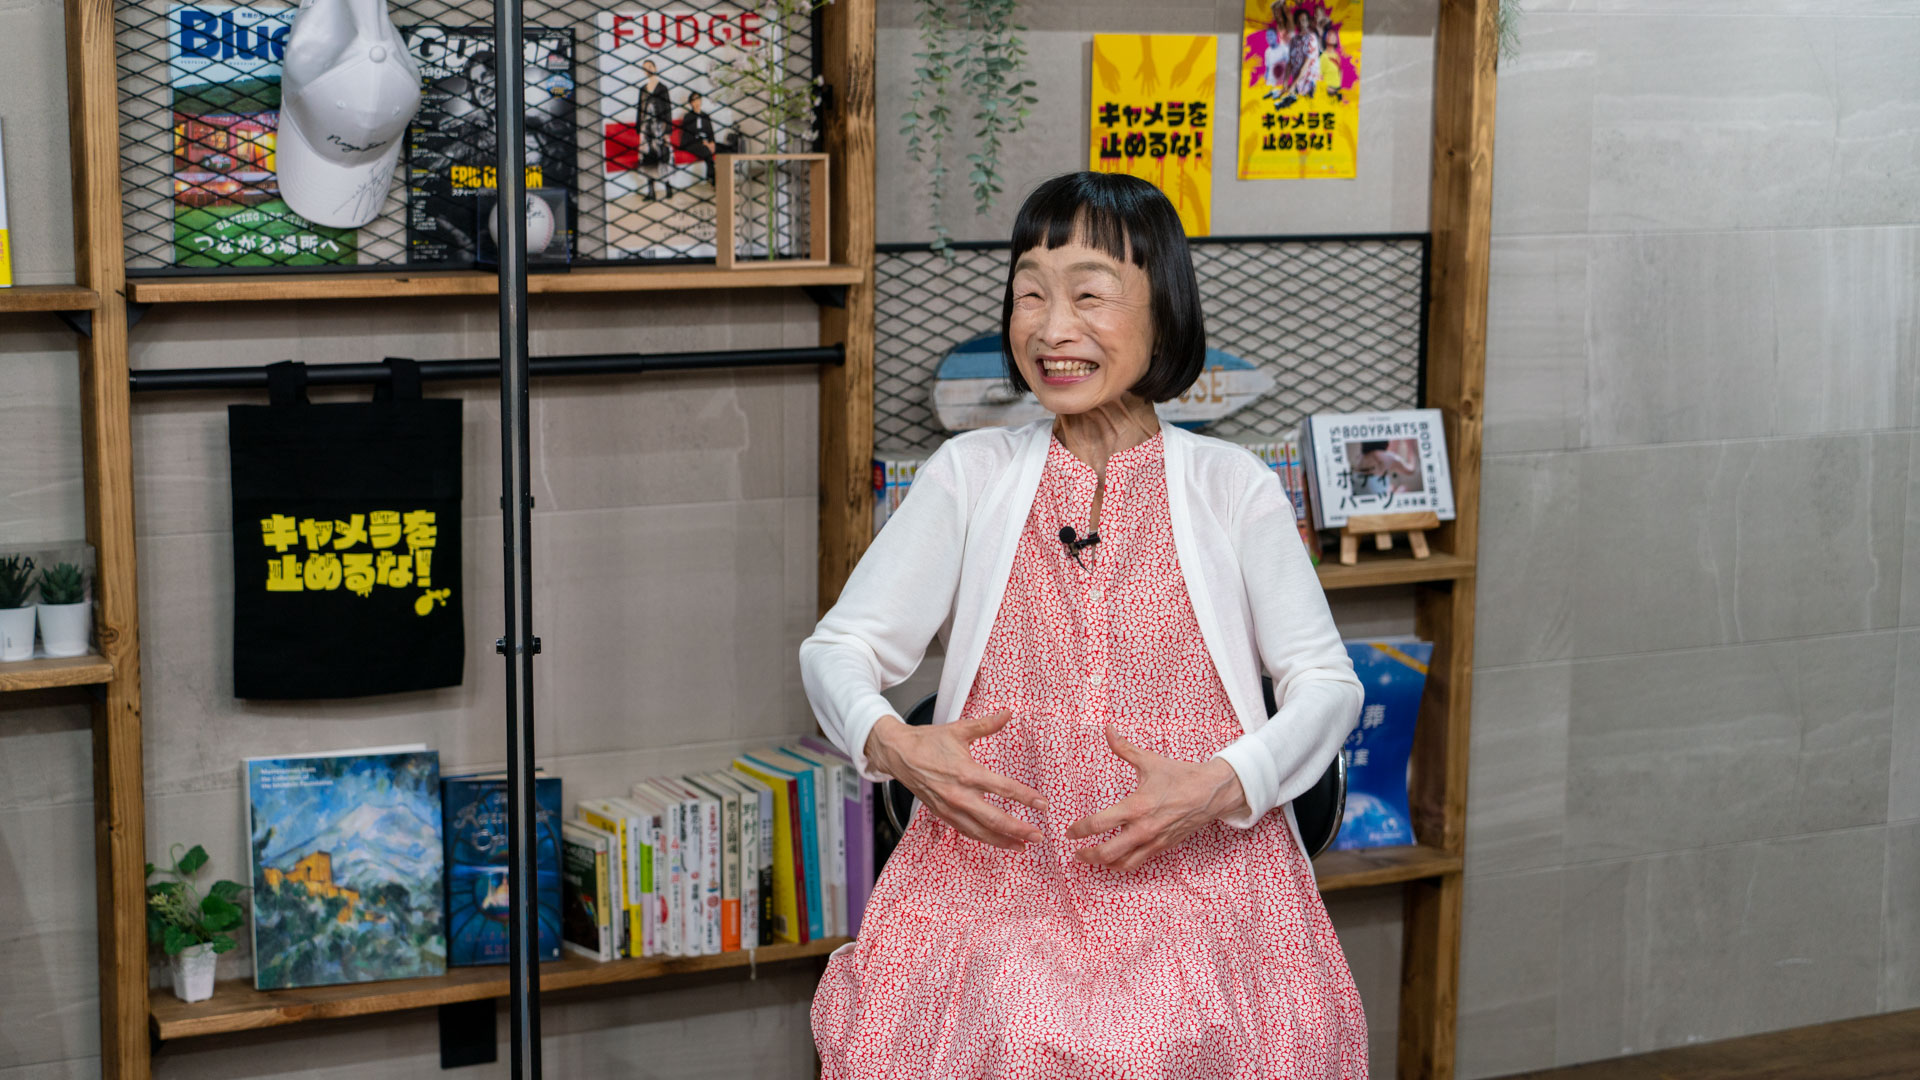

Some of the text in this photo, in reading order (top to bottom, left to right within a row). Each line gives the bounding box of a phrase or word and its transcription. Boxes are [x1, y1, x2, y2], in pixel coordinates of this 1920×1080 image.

[613, 13, 761, 49] FUDGE
[1098, 101, 1208, 128] キャメラを
[1261, 112, 1335, 131] キャメラを
[450, 165, 482, 189] ERIC
[193, 234, 341, 256] つながる場所へ
[1342, 421, 1419, 439] BODYPARTS
[260, 510, 438, 553] キャメラを
[741, 802, 758, 880] 野村ノート
